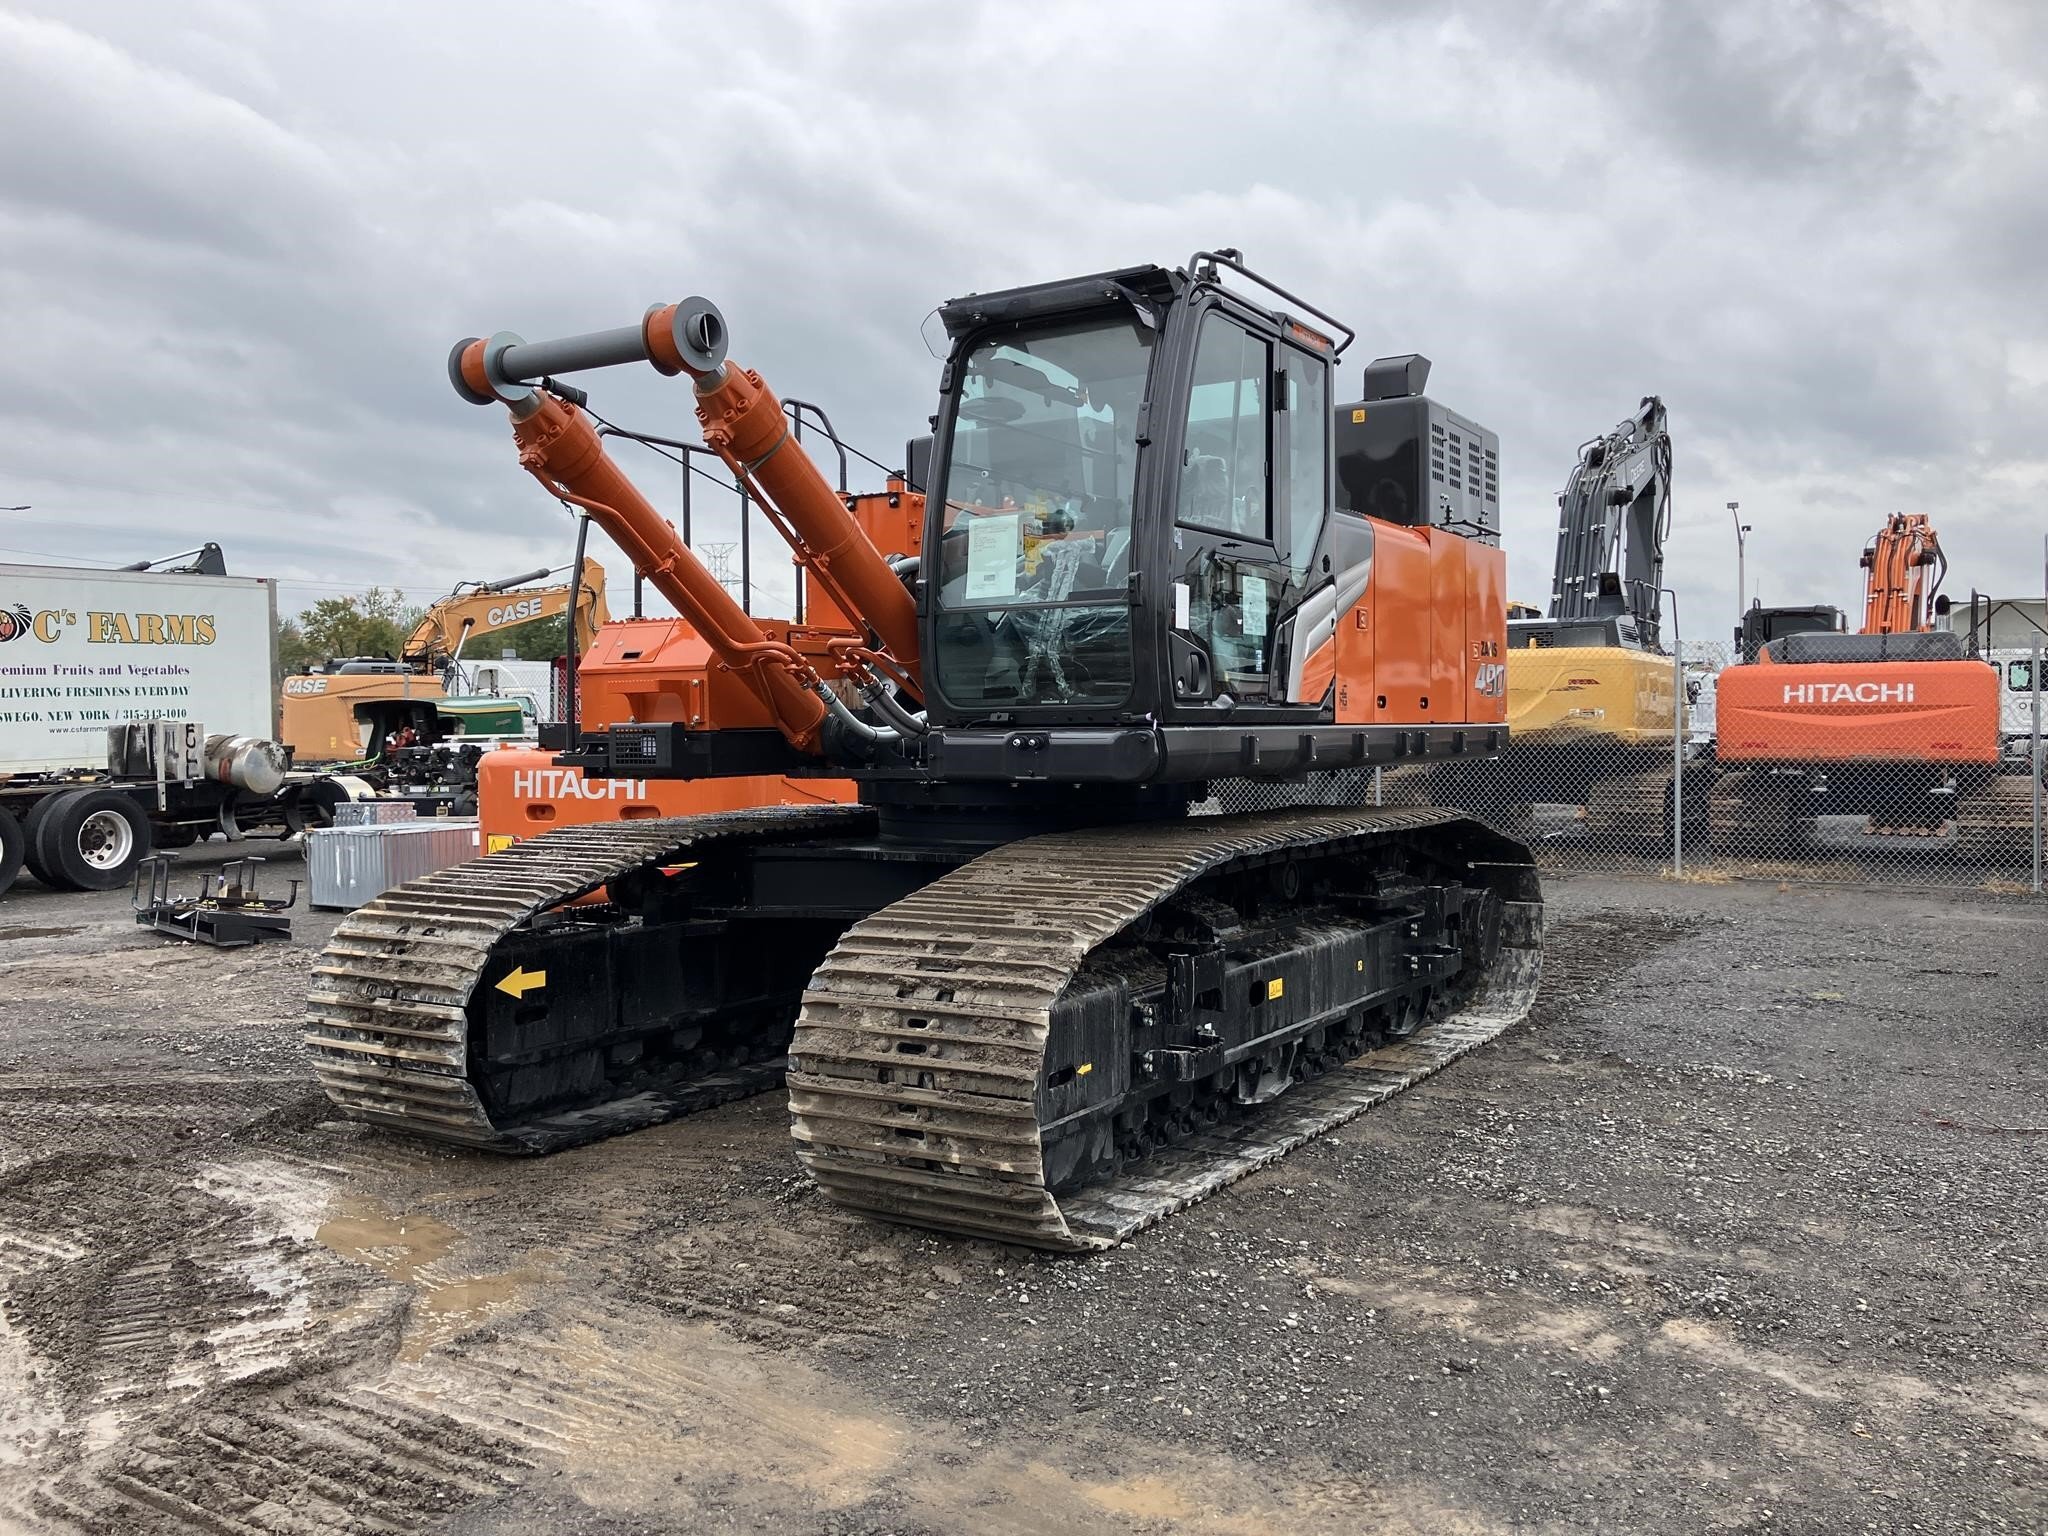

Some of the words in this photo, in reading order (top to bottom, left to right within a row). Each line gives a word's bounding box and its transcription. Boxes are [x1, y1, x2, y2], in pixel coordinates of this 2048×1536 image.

[487, 597, 542, 626] CASE
[33, 609, 77, 644] C's
[87, 611, 217, 645] FARMS
[53, 663, 94, 676] Fruits
[99, 664, 122, 676] and
[128, 663, 190, 678] Vegetables
[1475, 663, 1506, 698] 490
[66, 686, 131, 698] FRESHNESS
[135, 685, 190, 697] EVERYDAY
[287, 678, 328, 694] CASE
[1783, 682, 1915, 705] HITACHI
[47, 710, 74, 722] NEW
[79, 709, 110, 721] YORK
[514, 770, 647, 800] HITACHI
